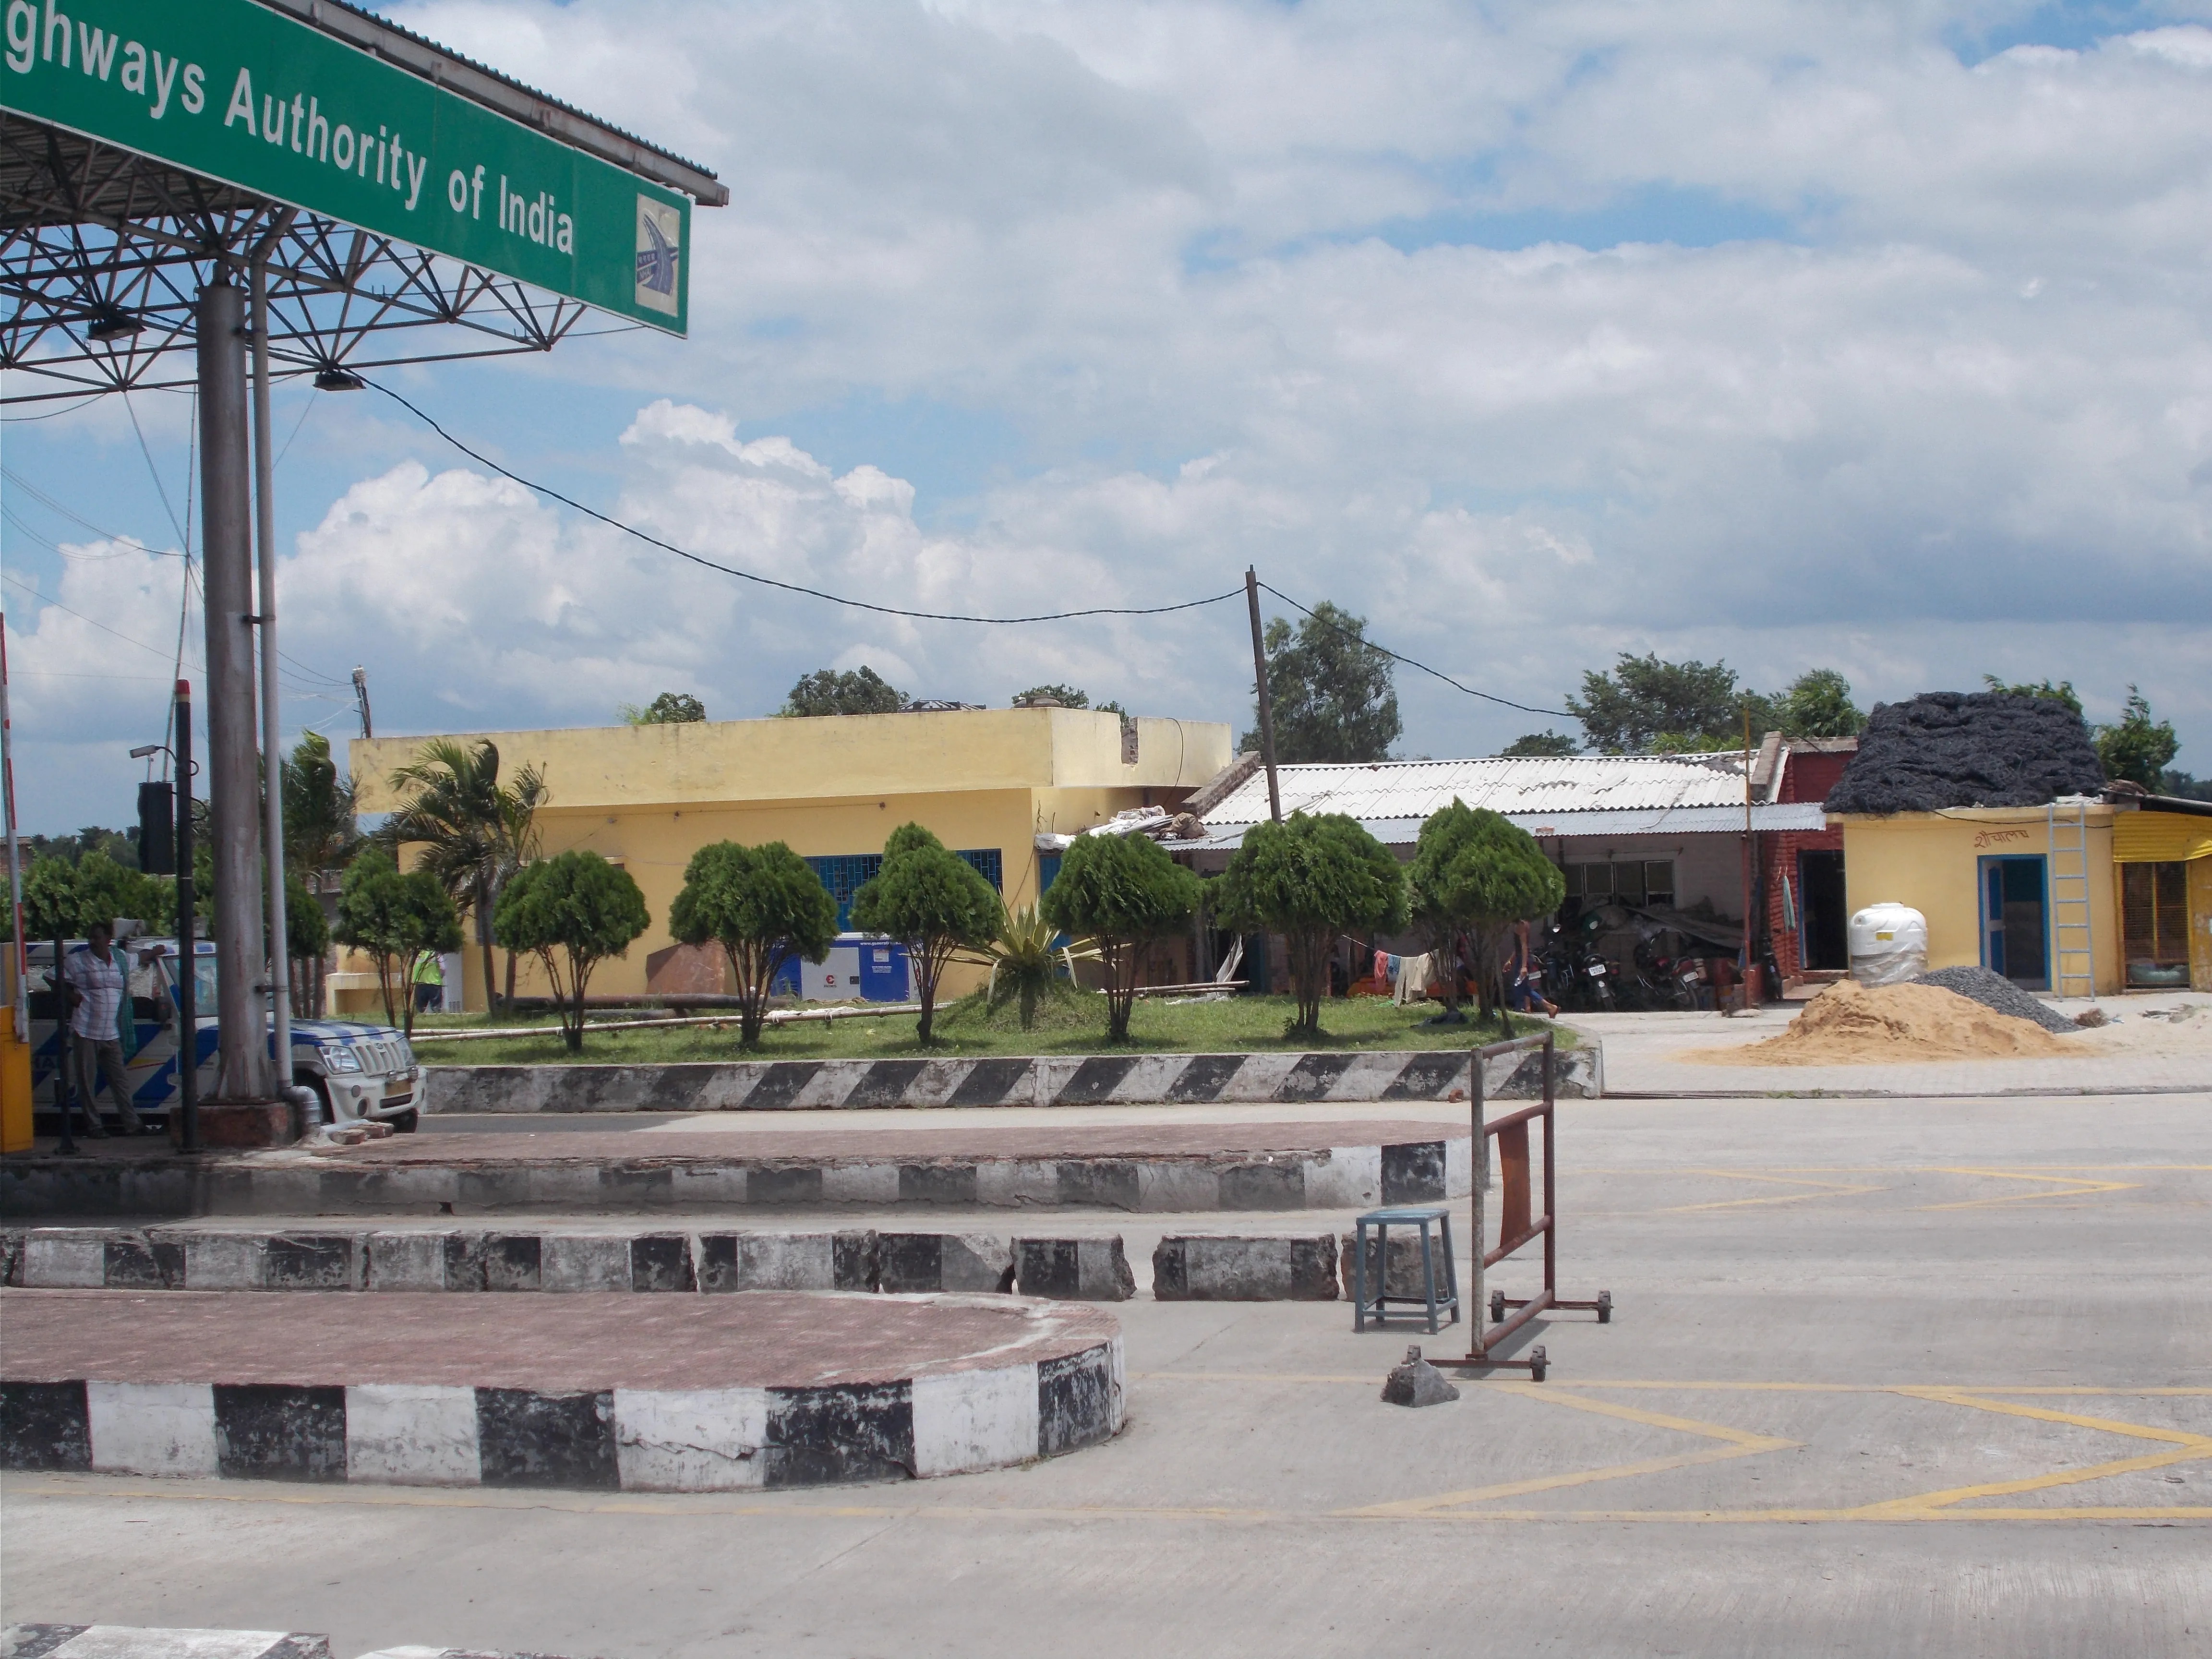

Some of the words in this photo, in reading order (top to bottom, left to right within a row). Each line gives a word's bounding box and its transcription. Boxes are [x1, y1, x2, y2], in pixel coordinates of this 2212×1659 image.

[6, 0, 205, 119] ghways
[224, 67, 426, 211] Authority
[448, 164, 485, 220] of
[499, 174, 573, 255] India
